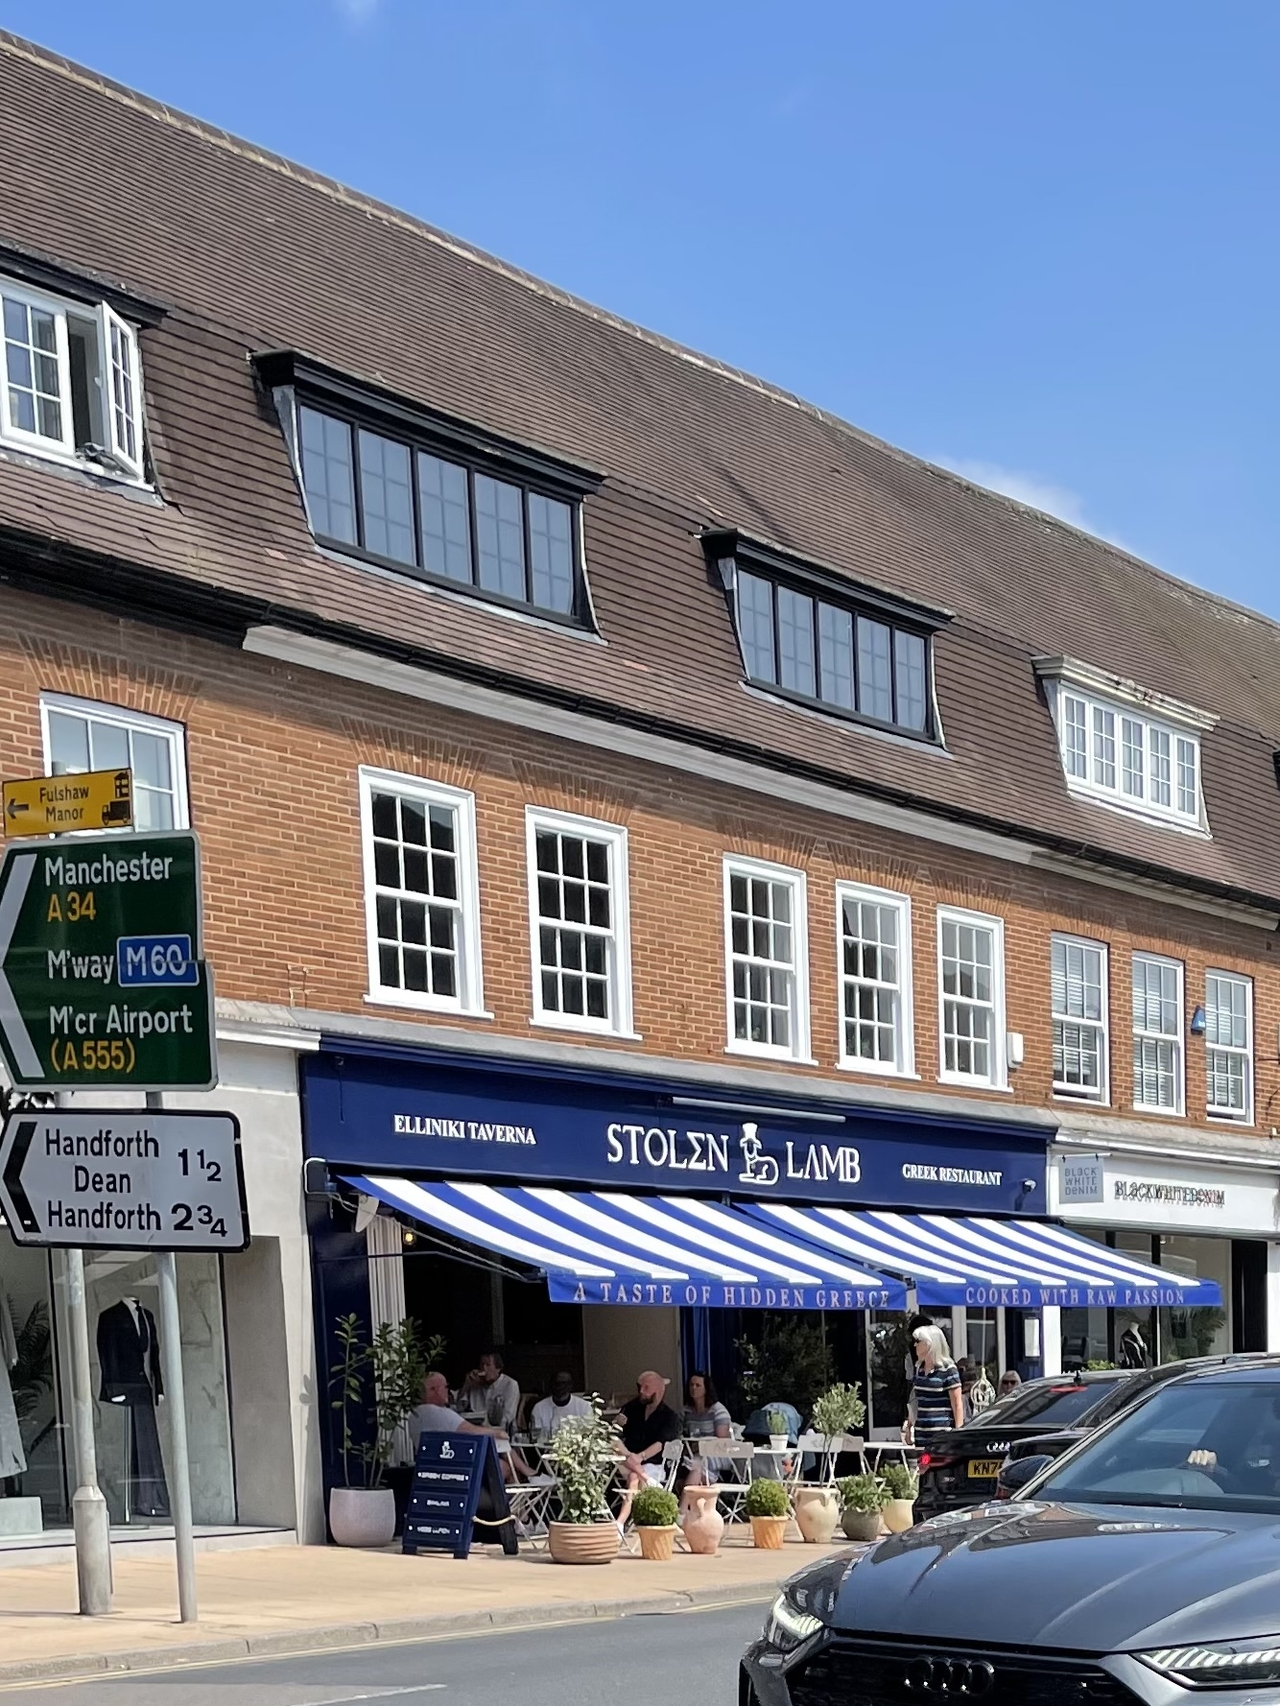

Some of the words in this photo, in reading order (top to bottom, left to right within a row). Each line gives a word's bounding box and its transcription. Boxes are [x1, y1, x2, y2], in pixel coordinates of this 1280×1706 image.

[39, 784, 90, 803] Fulshaw
[45, 805, 85, 823] Manor
[44, 852, 173, 887] Manchester
[47, 892, 96, 922] A34
[48, 950, 114, 984] M'way
[126, 944, 187, 979] M60
[50, 1006, 97, 1035] M'cr
[106, 1003, 193, 1040] Airport
[50, 1038, 135, 1073] (A555)
[394, 1114, 465, 1139] ELLINIKI
[468, 1122, 537, 1145] TAVERNA
[45, 1130, 160, 1159] Handforth
[74, 1167, 132, 1194] Dean
[902, 1163, 938, 1181] GREEK
[939, 1167, 1002, 1186] RESTAURANT
[1065, 1177, 1097, 1186] WHITE
[47, 1201, 161, 1231] Handforth
[573, 1282, 587, 1301] A
[600, 1282, 673, 1304] TASTE
[685, 1285, 711, 1305] OF
[723, 1286, 804, 1307] HIDDEN
[816, 1290, 889, 1308] GREECE
[965, 1287, 1031, 1304] COOKED
[1039, 1287, 1079, 1304] WITH
[1087, 1288, 1117, 1304] RAW
[1125, 1288, 1185, 1305] PASSION
